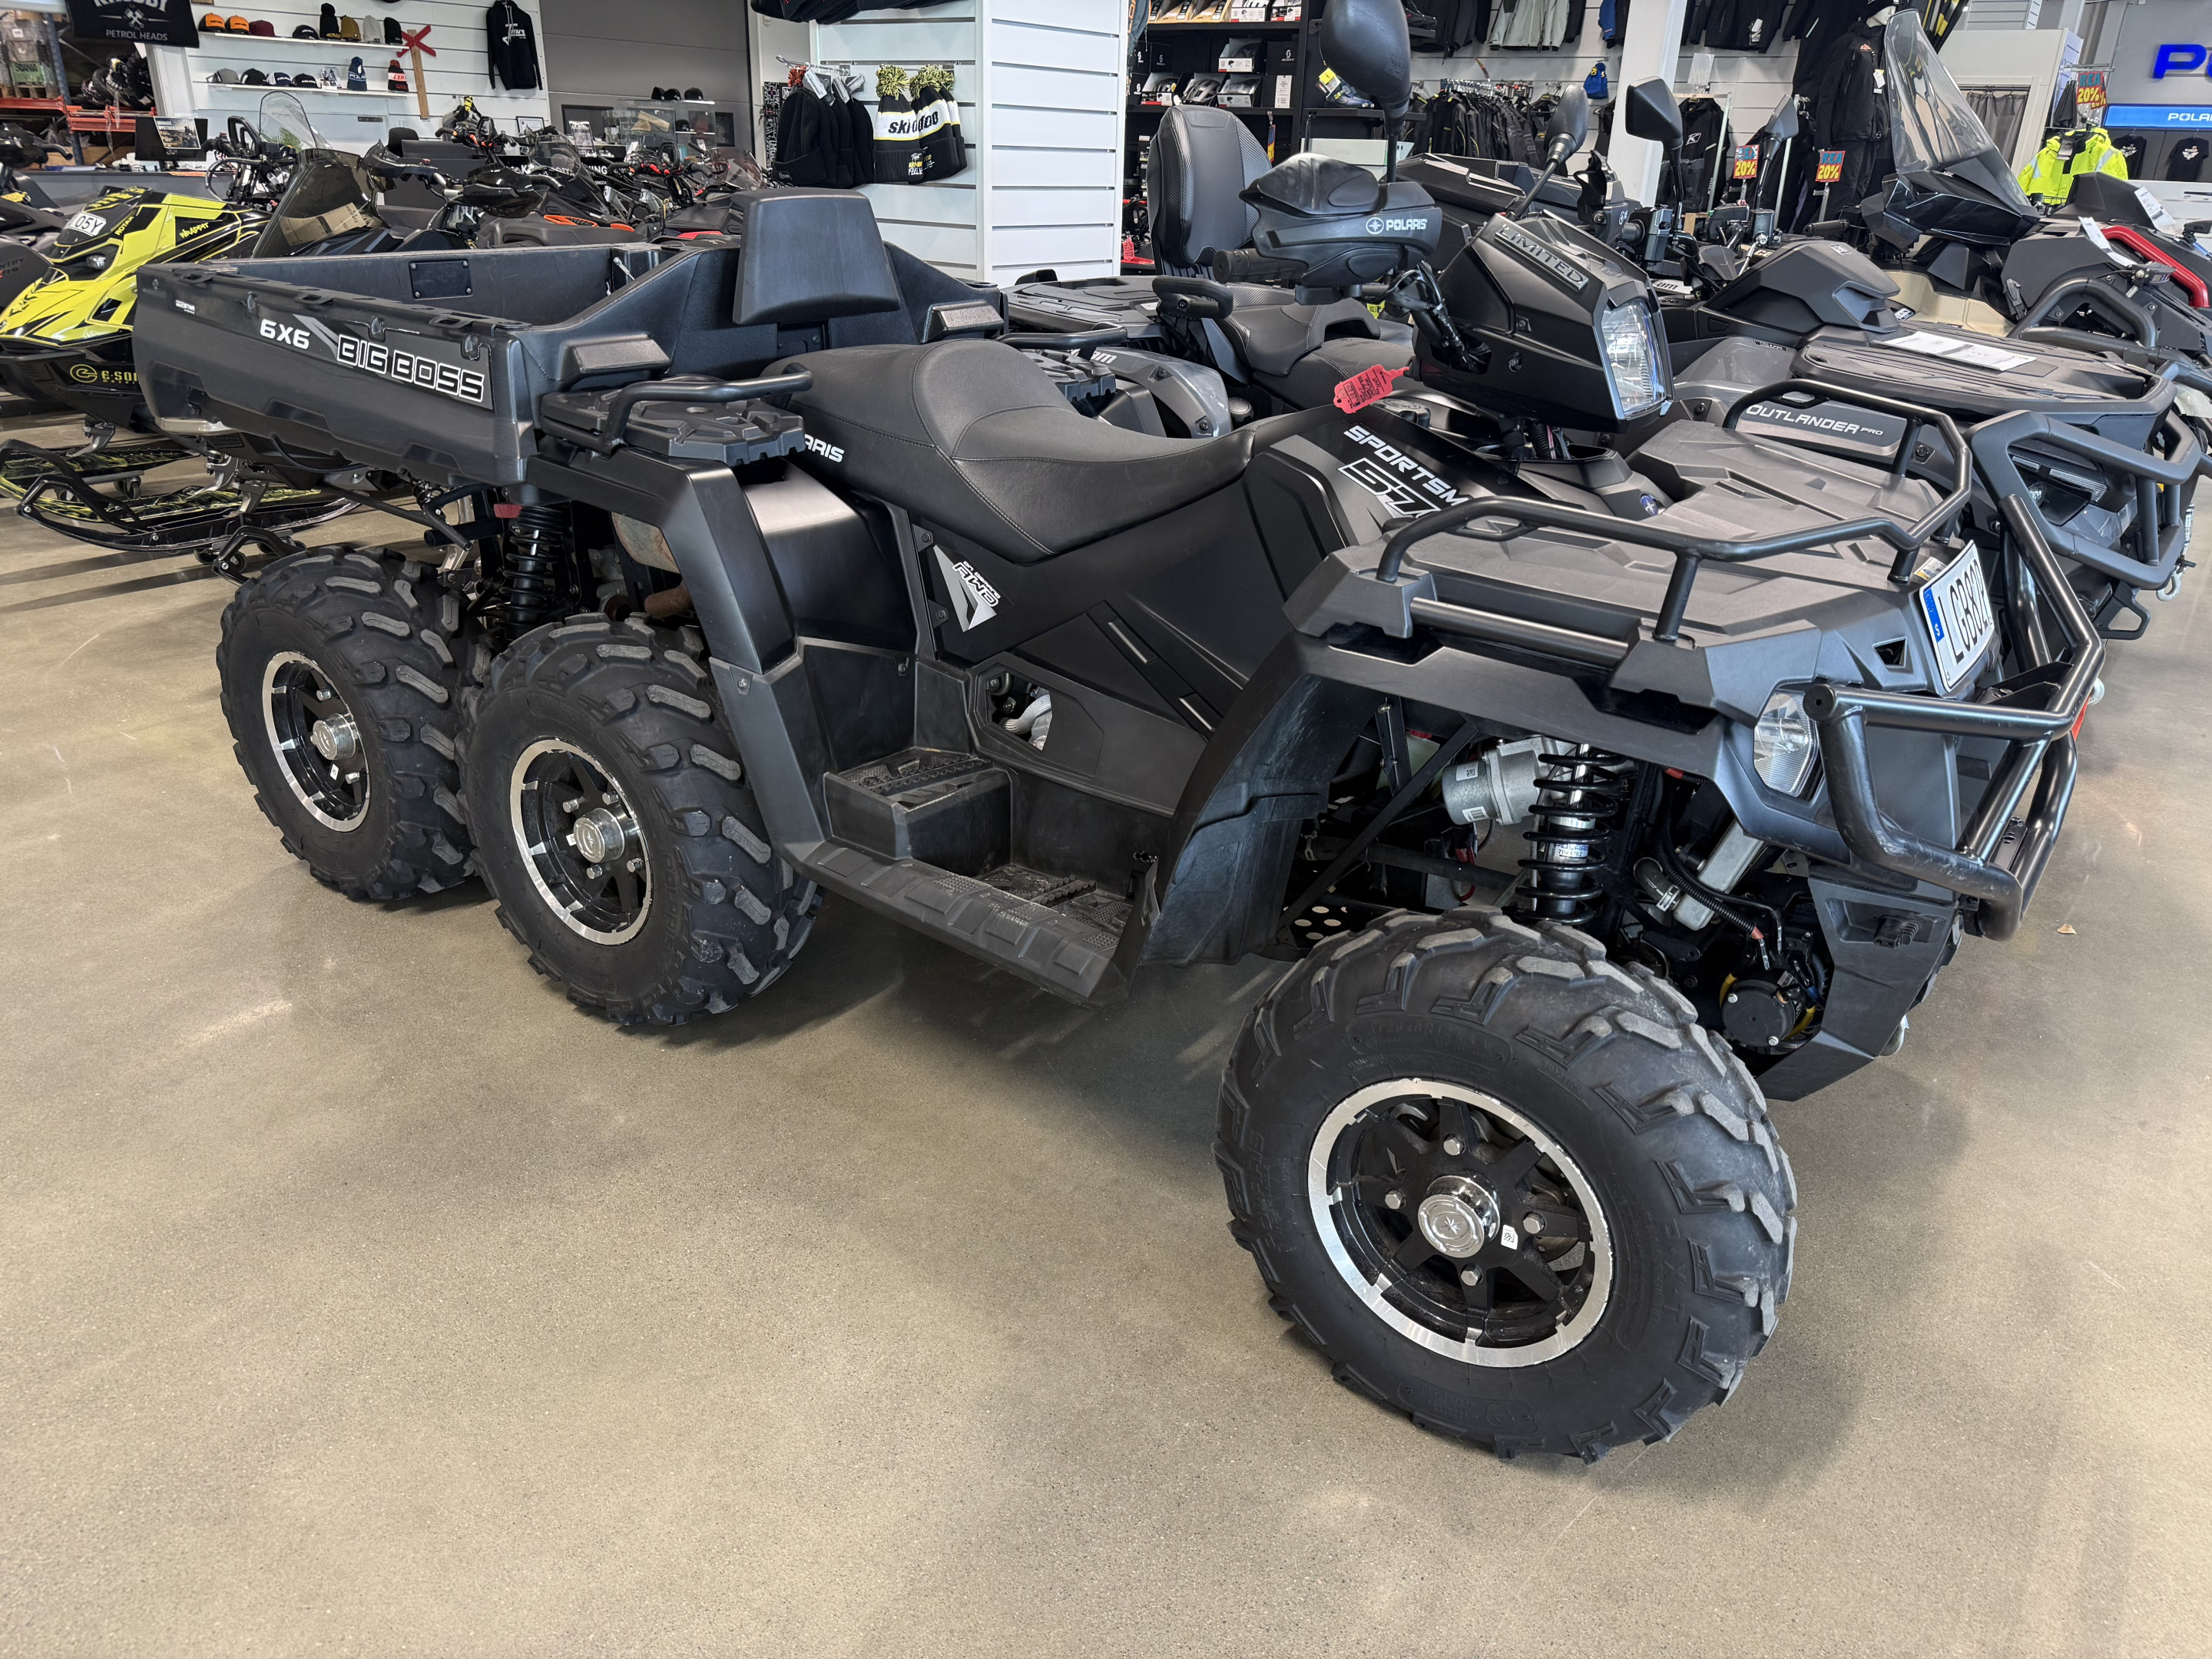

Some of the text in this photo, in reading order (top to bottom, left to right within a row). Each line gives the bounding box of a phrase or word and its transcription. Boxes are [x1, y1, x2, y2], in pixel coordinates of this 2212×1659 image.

[106, 29, 168, 41] PETROL HEADS
[2079, 73, 2101, 87] REA
[2078, 87, 2100, 103] 20%
[2167, 113, 2212, 121] POLA
[1821, 153, 1843, 164] REA
[1734, 161, 1756, 177] 20%
[1817, 165, 1839, 180] 20%
[75, 215, 104, 233] 05Y
[114, 216, 134, 236] ROTAX
[179, 222, 209, 239] WRAPPIT
[1386, 218, 1428, 230] POLARIS
[1499, 224, 1584, 284] LIMITED
[260, 319, 310, 350] 6X6
[336, 334, 485, 402] BIG BOSS
[1746, 404, 1883, 435] OUTLANDER PRO
[804, 433, 845, 462] ARIS
[1343, 426, 1469, 507] SPORTSM
[1337, 457, 1442, 518] 57
[952, 561, 998, 607] AWD
[1939, 558, 1988, 664] LGB82P
[1935, 623, 1941, 636] S
